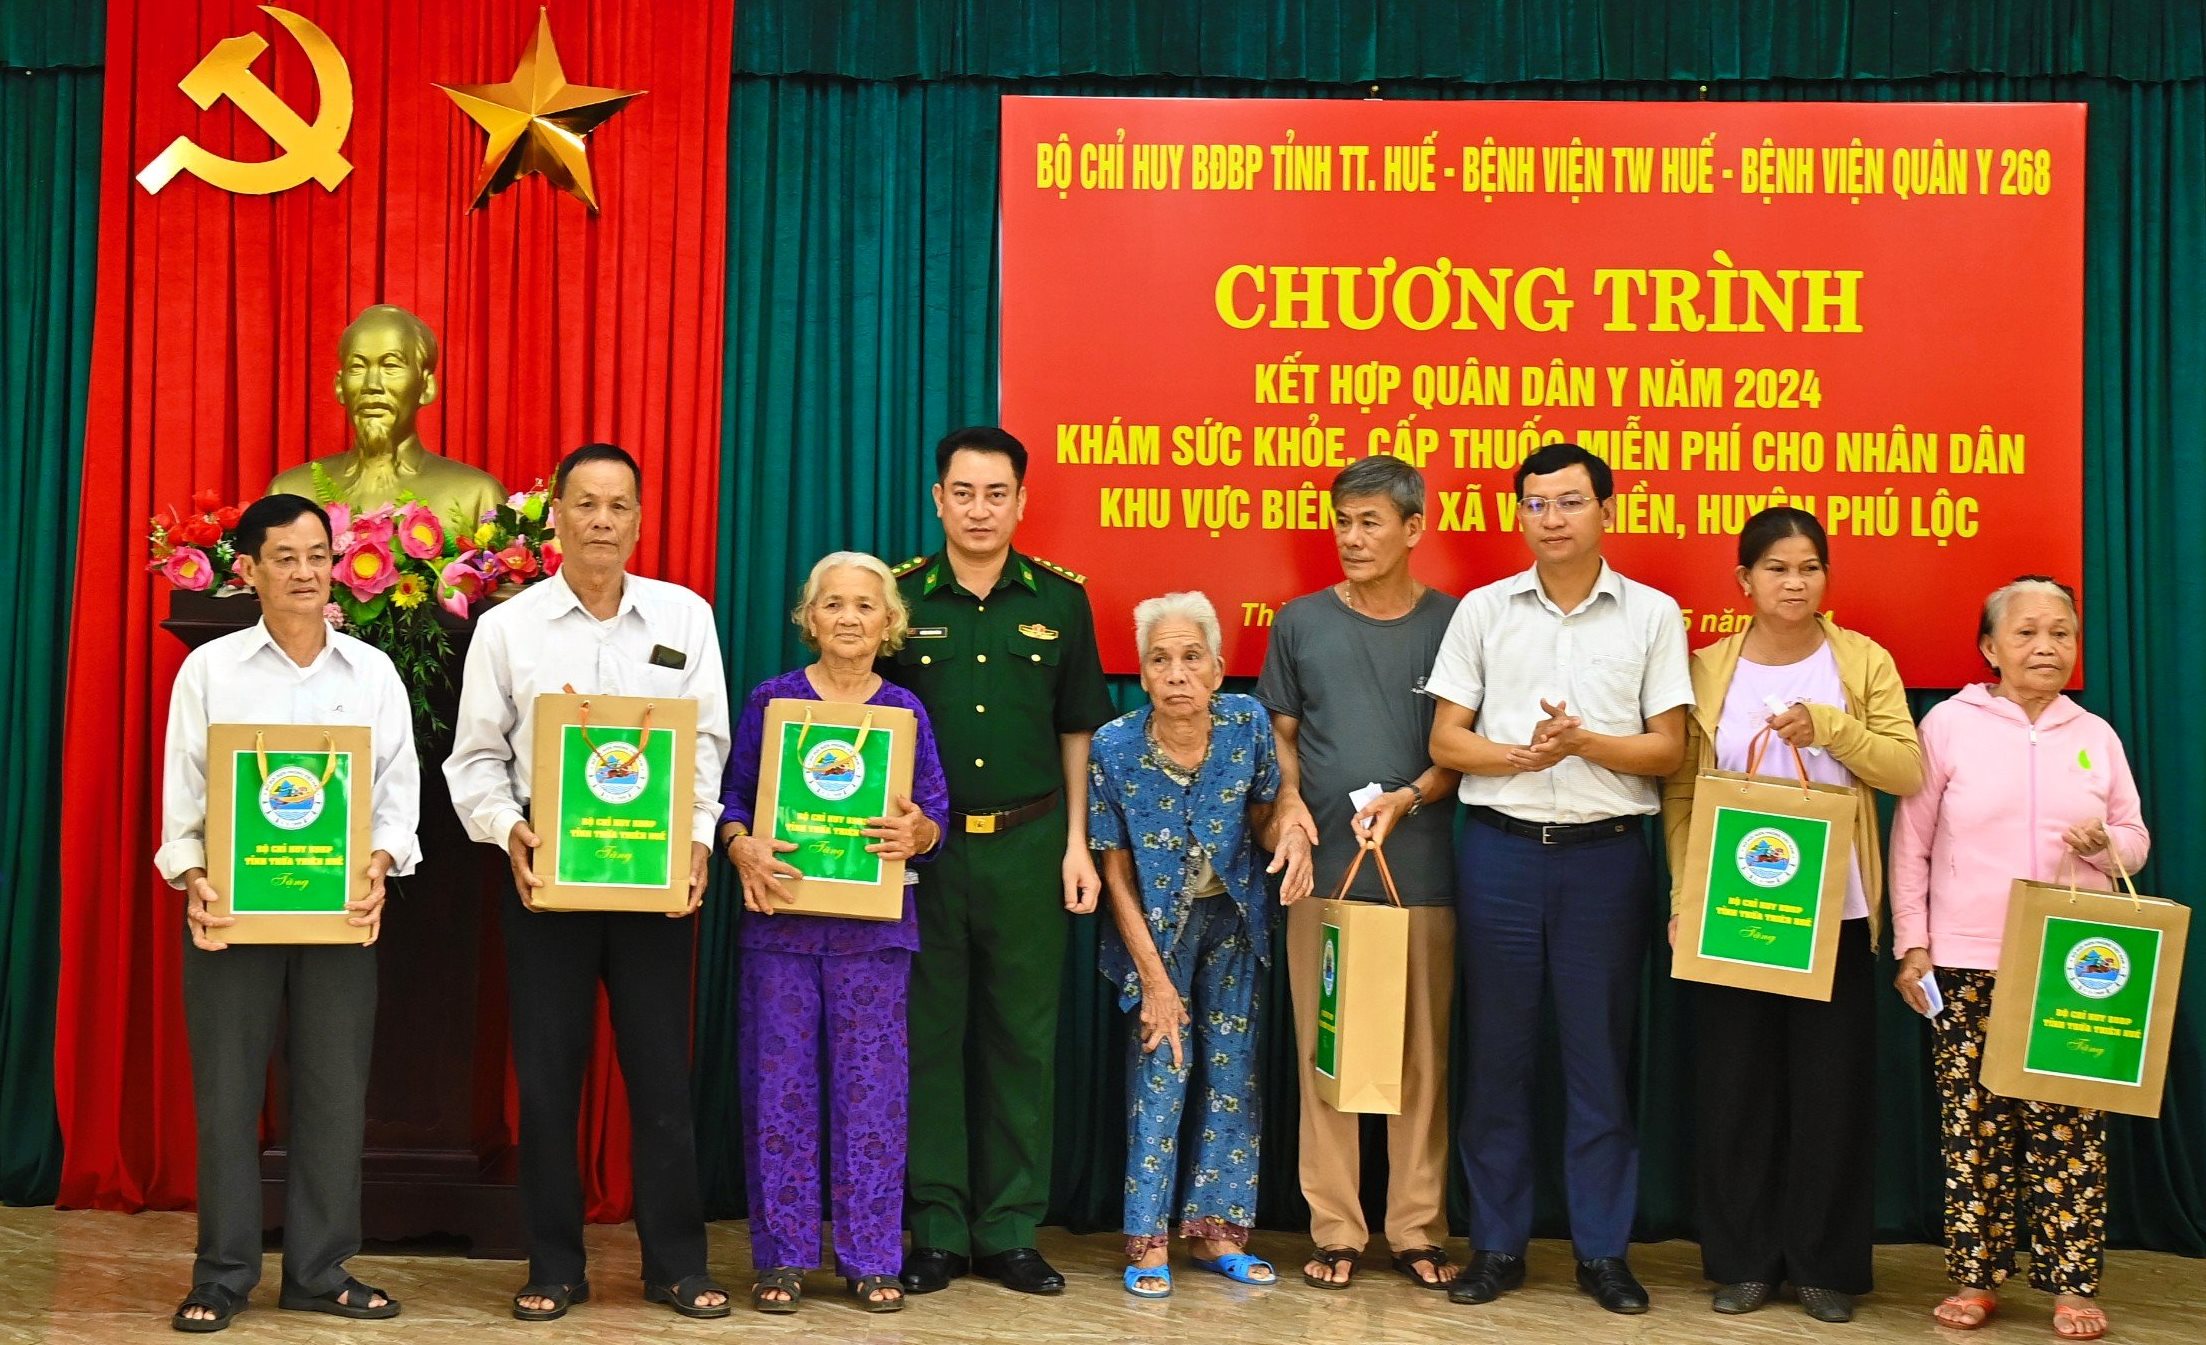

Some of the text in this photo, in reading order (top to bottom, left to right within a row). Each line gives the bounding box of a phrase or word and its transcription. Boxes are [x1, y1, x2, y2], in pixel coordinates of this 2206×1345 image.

[1036, 132, 1073, 200] BỘ
[1080, 127, 1126, 190] CHỈ
[1132, 143, 1184, 191] HUY
[1191, 143, 1263, 191] BĐBP
[1270, 128, 1332, 192] TỈNH
[1338, 145, 1377, 192] TT.
[1383, 130, 1438, 193] HUẾ
[1462, 136, 1534, 203] BỆNH
[1542, 136, 1604, 203] VIỆN
[1611, 147, 1654, 193] TW
[1661, 131, 1717, 194] HUẾ
[1740, 137, 1814, 204] BỆNH
[1822, 137, 1885, 204] VIỆN
[1892, 138, 1968, 201] QUÂN
[1975, 148, 1993, 195] Y
[2000, 149, 2052, 196] 268
[1214, 249, 1864, 333] CHƯƠNG TRÌNH
[1255, 351, 1822, 414] KẾT HỢP QUÂN DÂN Y NĂM 2024
[1056, 416, 1161, 466] KHÁM
[1171, 417, 1243, 467] SỨC
[1367, 413, 1440, 469] CẤP
[1681, 422, 1741, 472] PHÍ
[1752, 430, 1825, 473] CHO
[1836, 423, 1938, 474] NHÂN
[1949, 424, 2025, 475] DÂN
[1100, 487, 1171, 529] KHU
[1182, 485, 1251, 538] VỰC
[1438, 483, 1487, 532] XÃ
[1603, 480, 1687, 540] IỀN,
[1827, 487, 1900, 537] PHÚ
[1911, 488, 1979, 547] LỘC
